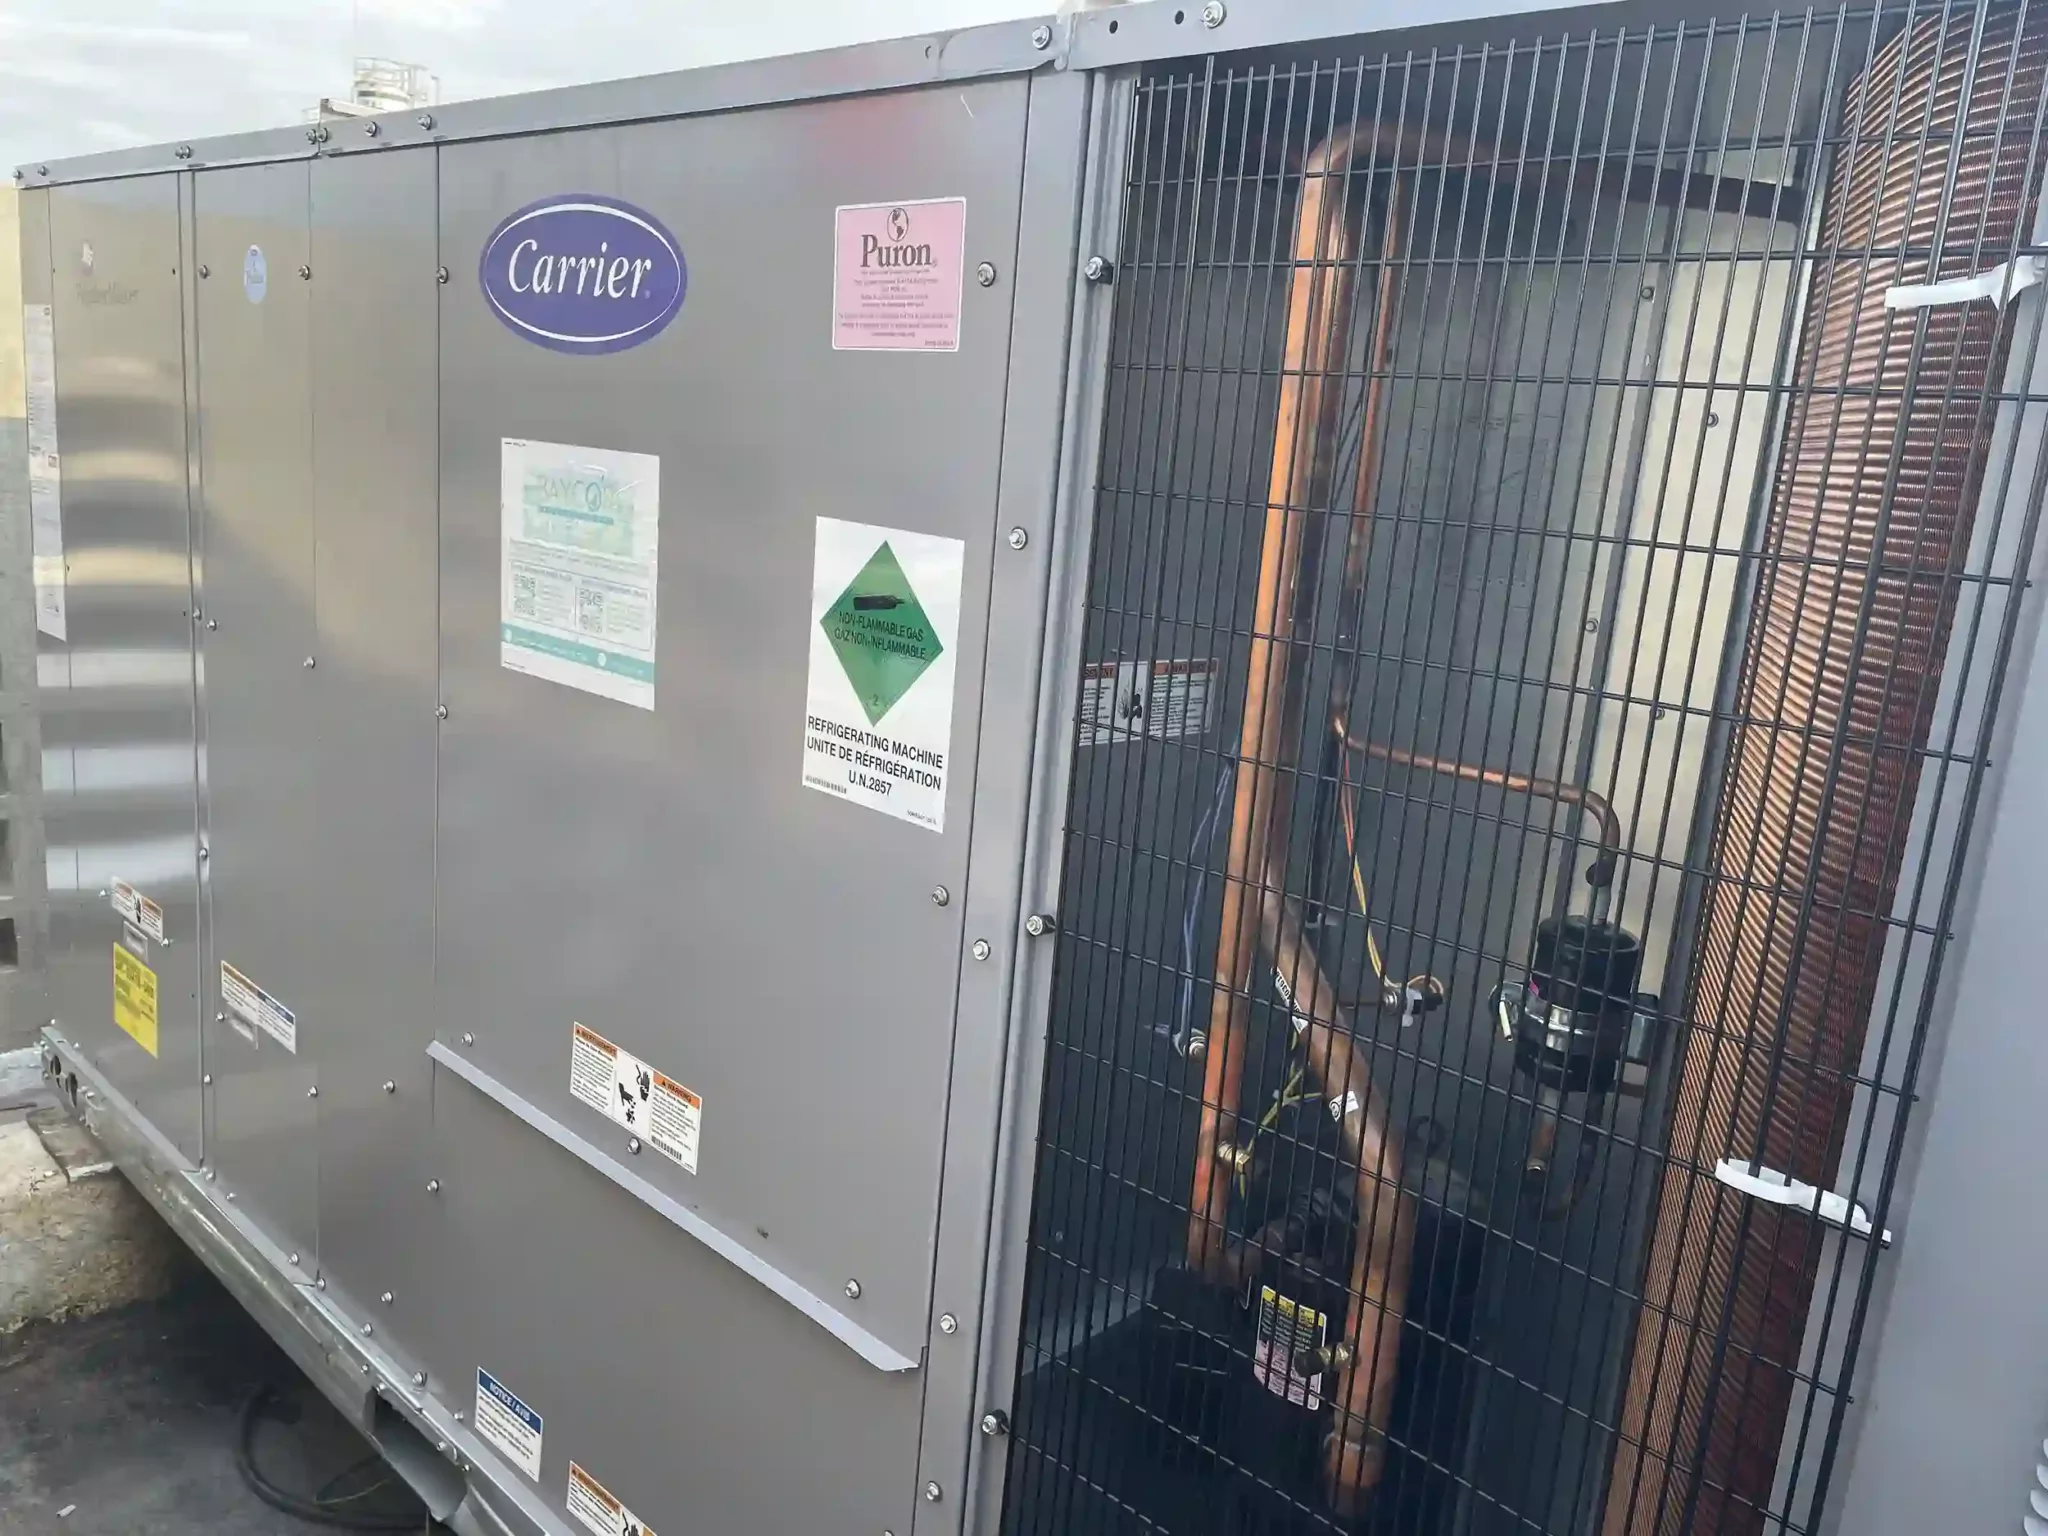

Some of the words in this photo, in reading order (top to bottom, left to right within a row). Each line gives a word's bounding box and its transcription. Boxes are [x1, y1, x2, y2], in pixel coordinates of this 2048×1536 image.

[860, 234, 931, 267] Puron
[509, 239, 652, 299] Carrier
[834, 628, 850, 641] GAZ
[839, 611, 905, 637] NON-FLAMMABLE
[906, 627, 924, 642] GAS
[808, 716, 889, 752] REFRIGERATING
[892, 741, 943, 769] MACHINE
[807, 737, 836, 756] UNITE
[839, 746, 852, 762] DE
[856, 750, 941, 791] RÉFRIGÉRATION
[849, 770, 892, 796] U.N.2857
[490, 1382, 512, 1406] NOTICE
